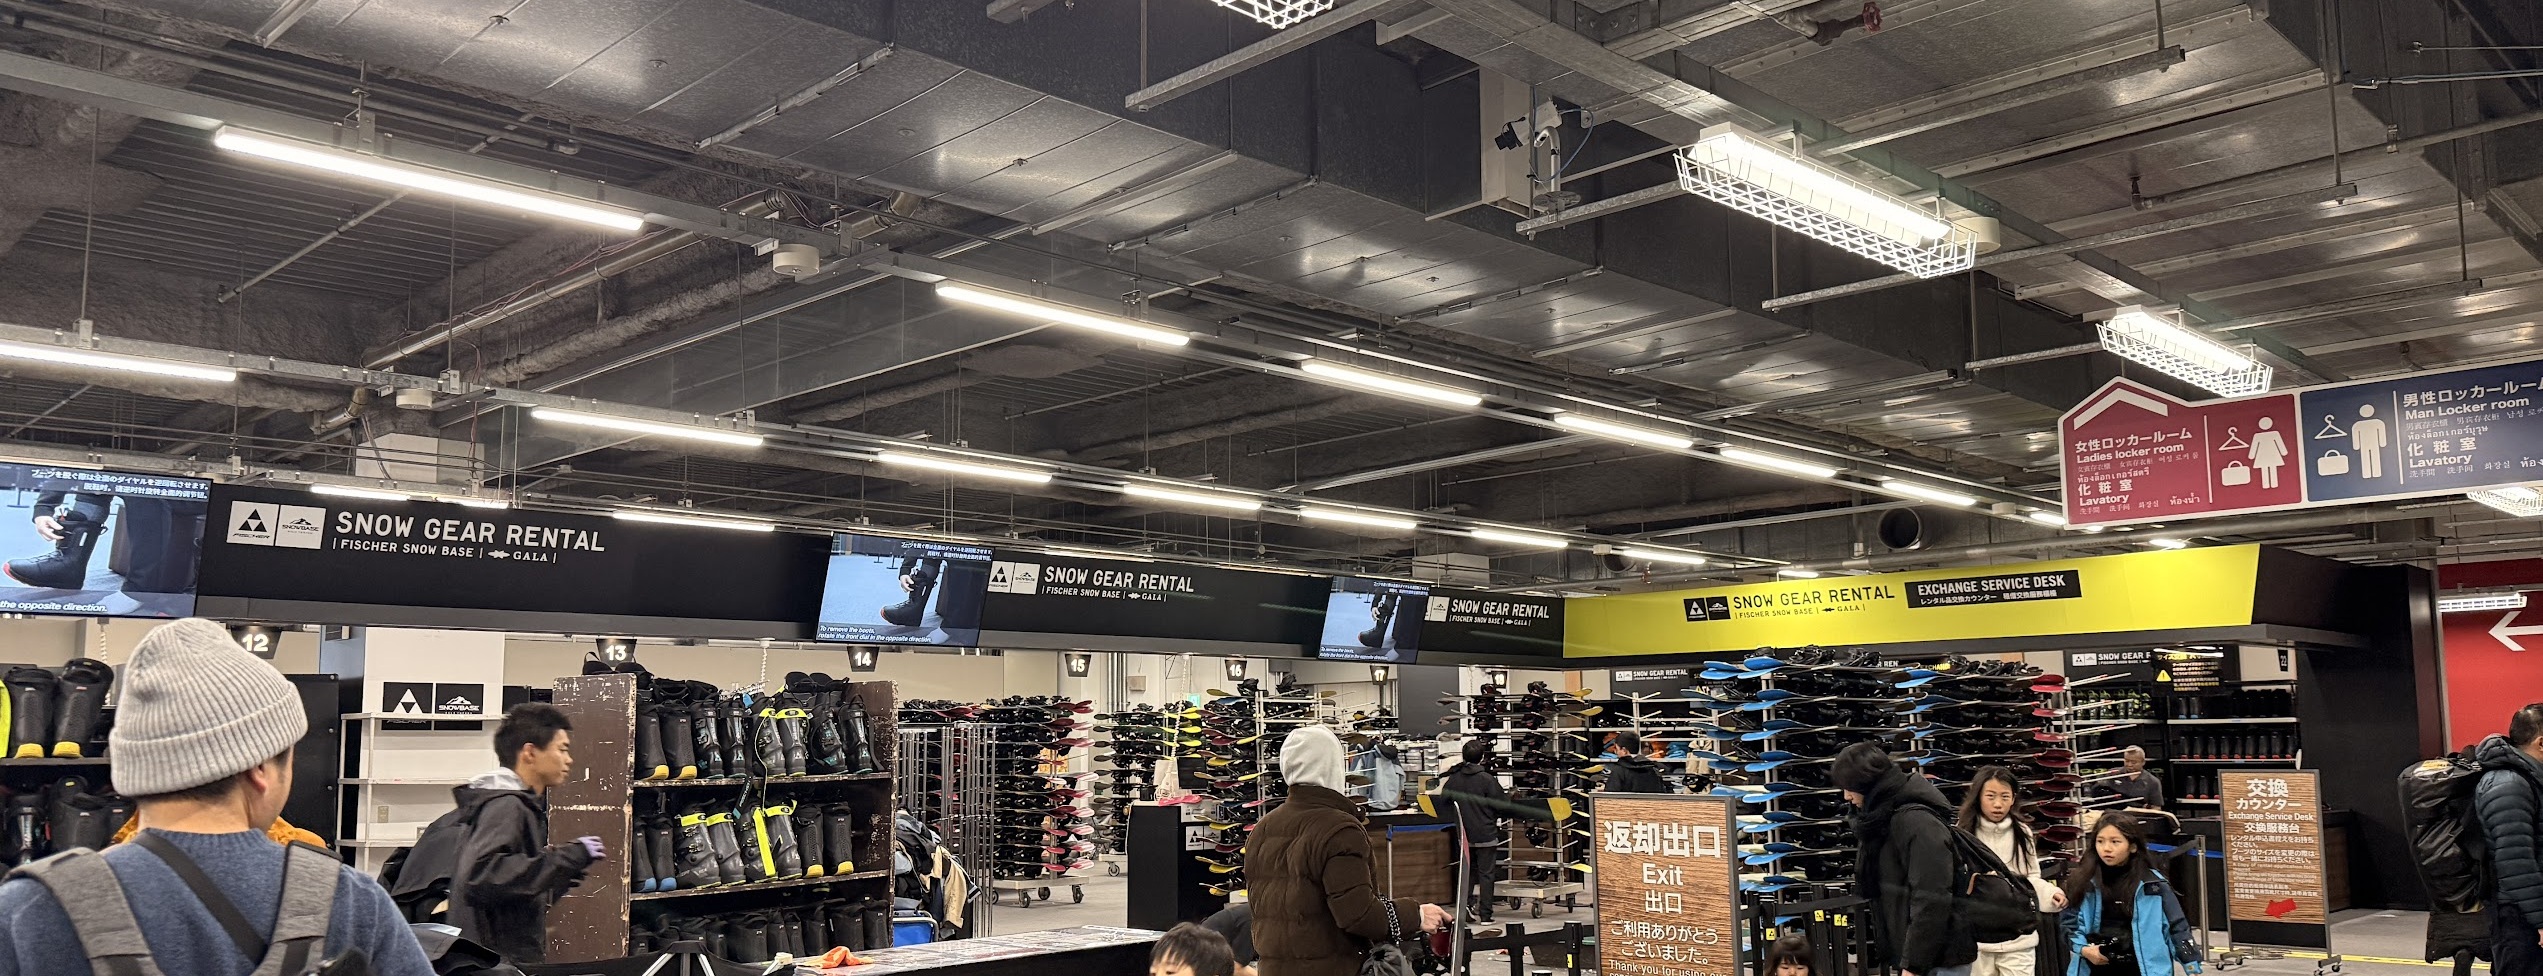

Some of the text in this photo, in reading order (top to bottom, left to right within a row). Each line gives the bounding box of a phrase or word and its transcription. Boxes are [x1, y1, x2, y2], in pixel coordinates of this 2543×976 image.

[2405, 397, 2529, 420] Man Locker room
[2075, 427, 2192, 453] 女性ロッカールーム
[2077, 443, 2184, 463] Ladies locker room
[2409, 454, 2472, 468] Lavatory
[2079, 494, 2129, 506] Lavatory
[335, 511, 605, 552] SNOW GEAR RENTAL
[341, 539, 548, 561] FISCHER SNOW BASE GALA
[1044, 566, 1194, 593] SNOW GEAR RENTAL
[1917, 574, 2066, 595] EXCHANGE SERVICE DESK
[1046, 586, 1162, 601] FISCHER SNOW BASE GALA
[1733, 585, 1895, 609] SNOW GEAR RENTAL
[1920, 594, 1997, 605] レンタル品交換カウンター
[18, 602, 61, 610] opposite
[63, 603, 107, 612] direction.
[1451, 599, 1549, 618] SNOW GEAR RENTAL
[1739, 610, 1770, 618] FISCHER
[1772, 608, 1791, 617] SNOW
[1794, 607, 1814, 615] BASE
[1452, 615, 1473, 623] FISCHER
[1474, 616, 1487, 624] SNOW
[1487, 617, 1500, 625] BASE
[242, 633, 269, 651] 12
[606, 645, 627, 661] 13
[855, 652, 871, 666] 14
[2098, 653, 2119, 661] SNOW
[2122, 652, 2143, 660] GEAR
[2280, 655, 2287, 666] 22
[1071, 659, 1085, 672] 15
[1230, 664, 1241, 677] 16
[2246, 778, 2289, 797] 交換
[2236, 798, 2302, 810] カウンター
[2228, 811, 2313, 821] Exchange Service Desk
[2244, 822, 2300, 833] 交換服務台
[1603, 820, 1720, 858] 返却出口
[1642, 862, 1684, 886] Exit
[1645, 890, 1682, 914] 出口
[1611, 920, 1718, 945] ご利用ありがとう
[1621, 939, 1708, 965] ございました。
[1608, 959, 1638, 972] Thank
[1641, 964, 1658, 976] you
[1662, 965, 1676, 975] for
